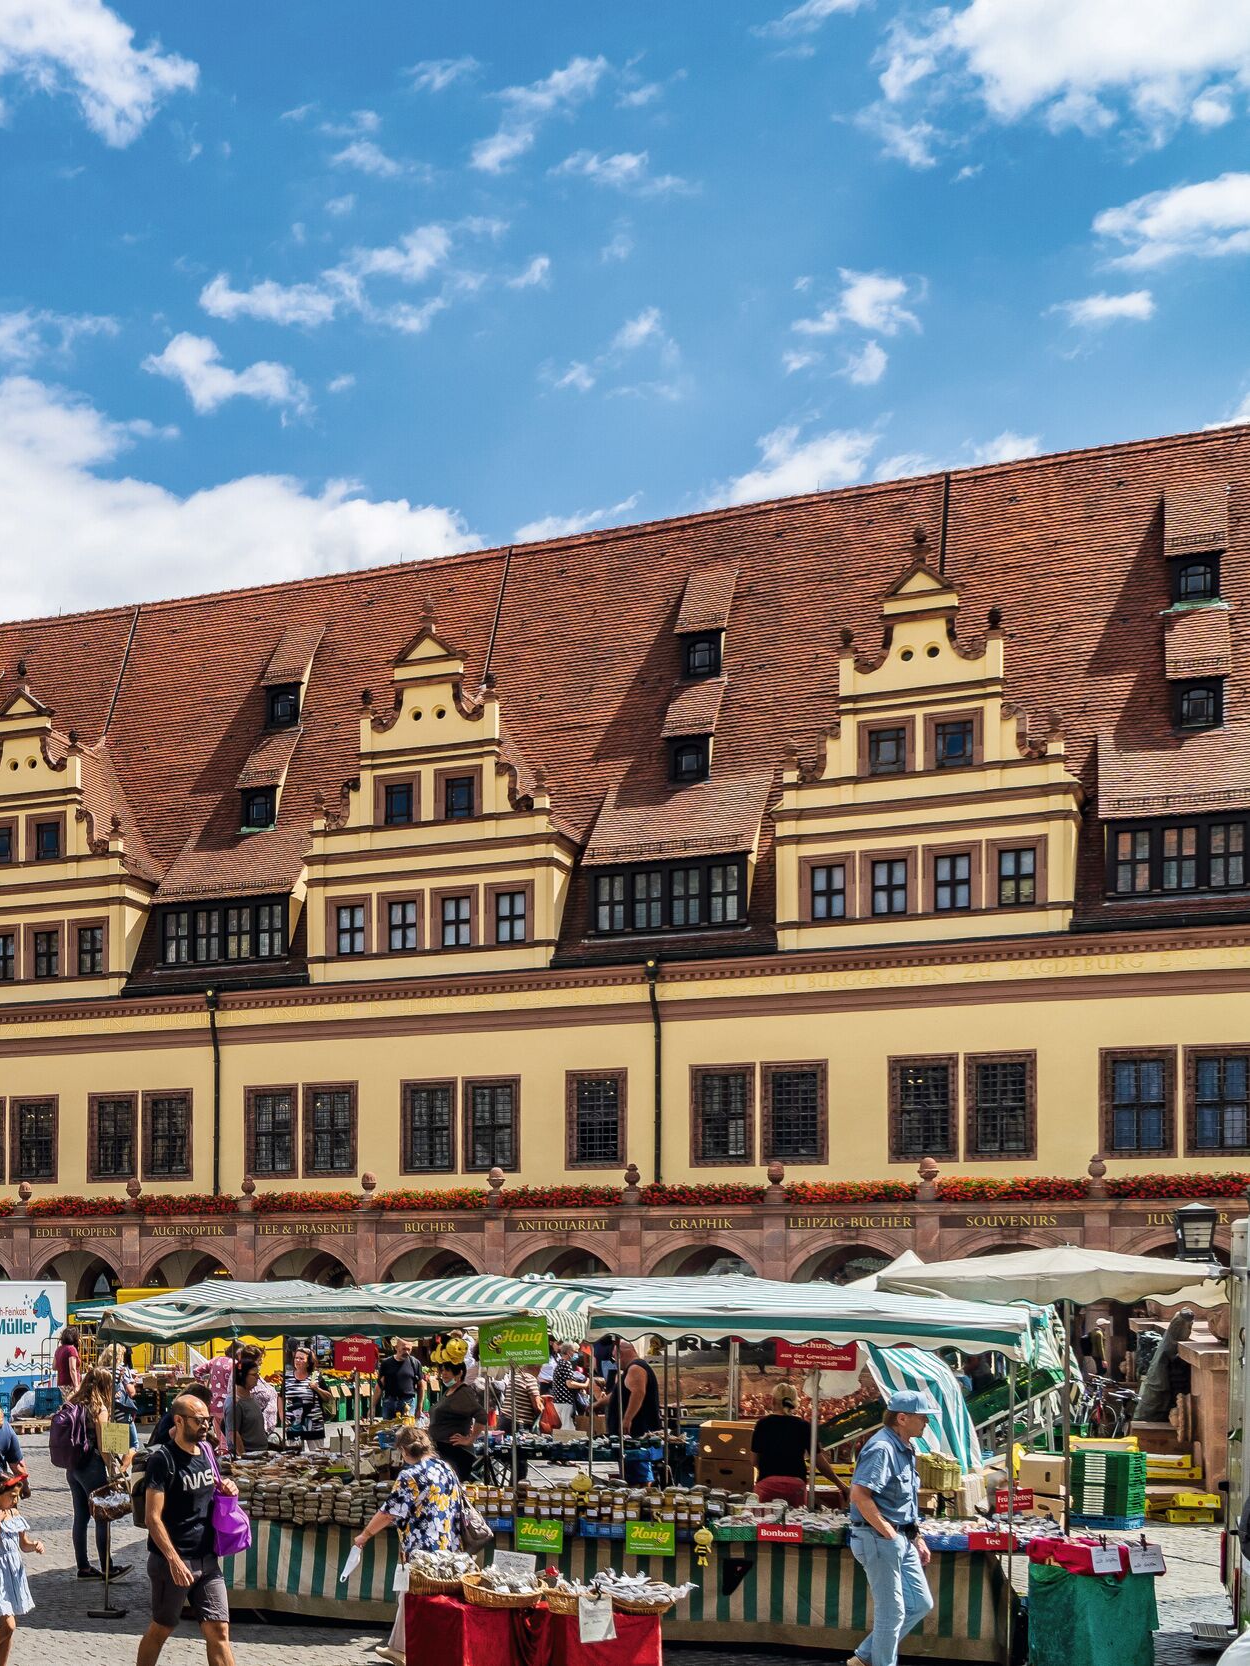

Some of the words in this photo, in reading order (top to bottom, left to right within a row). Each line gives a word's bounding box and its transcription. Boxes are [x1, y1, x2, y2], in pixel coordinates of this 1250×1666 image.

[258, 1224, 279, 1235] TEE
[280, 1224, 292, 1235] &
[295, 1219, 355, 1234] PRÄSENTE
[403, 1219, 456, 1233] BÜCHER
[516, 1219, 609, 1233] ANTIQUARIAT
[669, 1217, 734, 1230] GRAPHIK
[789, 1214, 913, 1229] LEIPZIG-BÜCHER
[965, 1214, 1057, 1227] SOUVENIRS
[36, 1227, 62, 1238] EDLE
[69, 1226, 118, 1238] TROPFEN
[152, 1224, 226, 1237] AUGENOPTIK
[502, 1328, 543, 1345] Honig
[182, 1468, 214, 1491] NAS
[997, 1493, 1032, 1503] Frühtetee
[521, 1522, 559, 1540] Honig
[631, 1526, 671, 1543] Honig
[760, 1528, 799, 1538] Bonbons
[985, 1537, 1001, 1545] Tee
